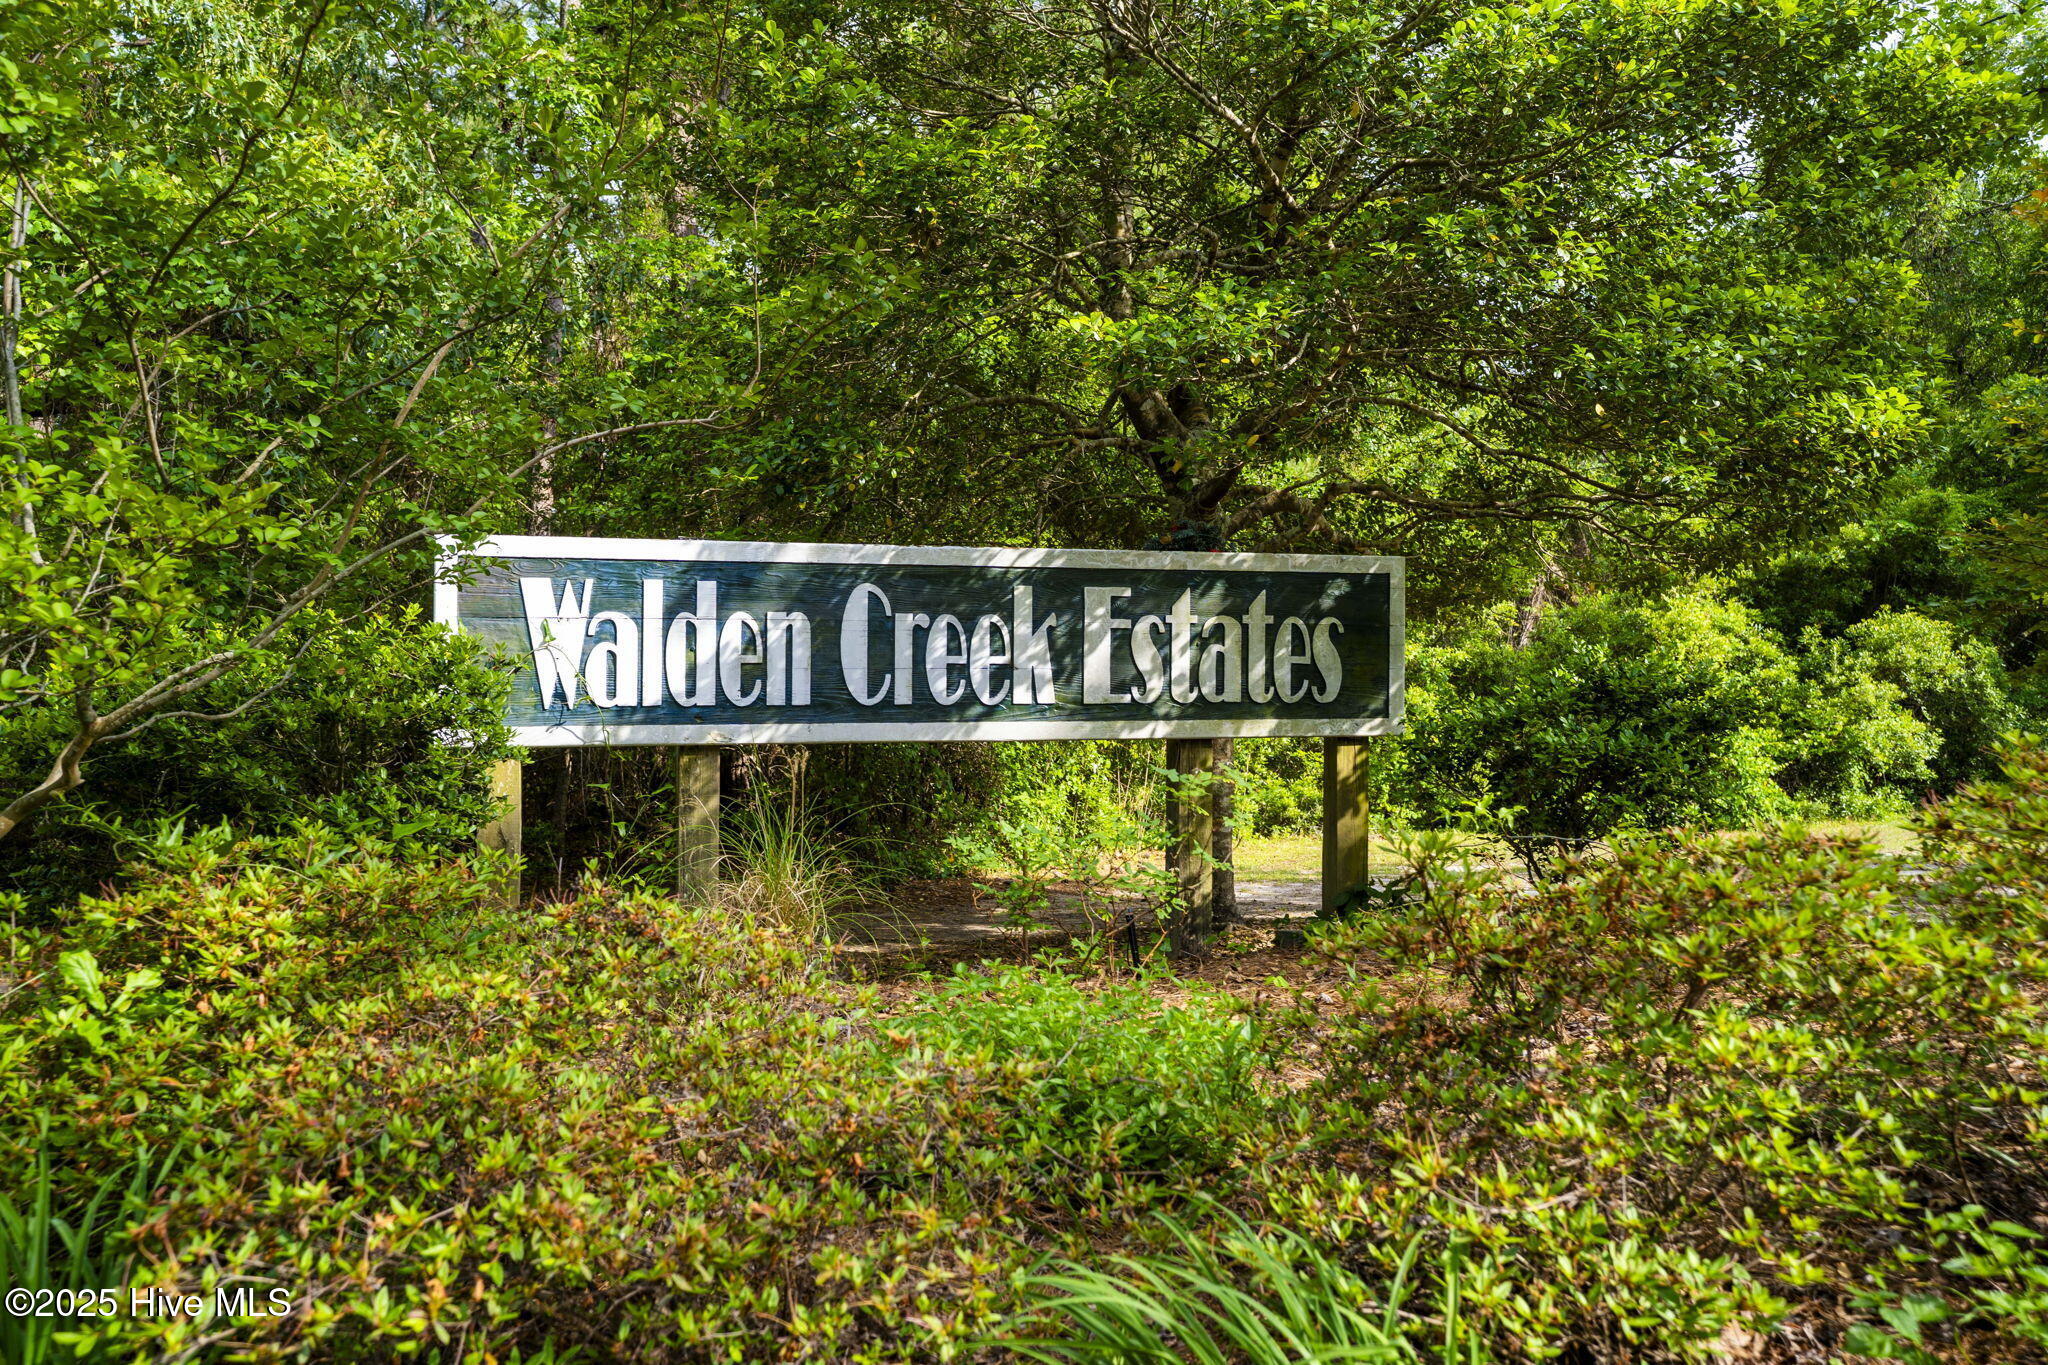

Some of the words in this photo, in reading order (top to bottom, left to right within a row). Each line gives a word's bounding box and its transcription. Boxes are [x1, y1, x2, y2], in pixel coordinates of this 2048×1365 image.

[519, 577, 811, 710] Walden
[840, 582, 1056, 706] Creek
[1083, 586, 1344, 704] Estates
